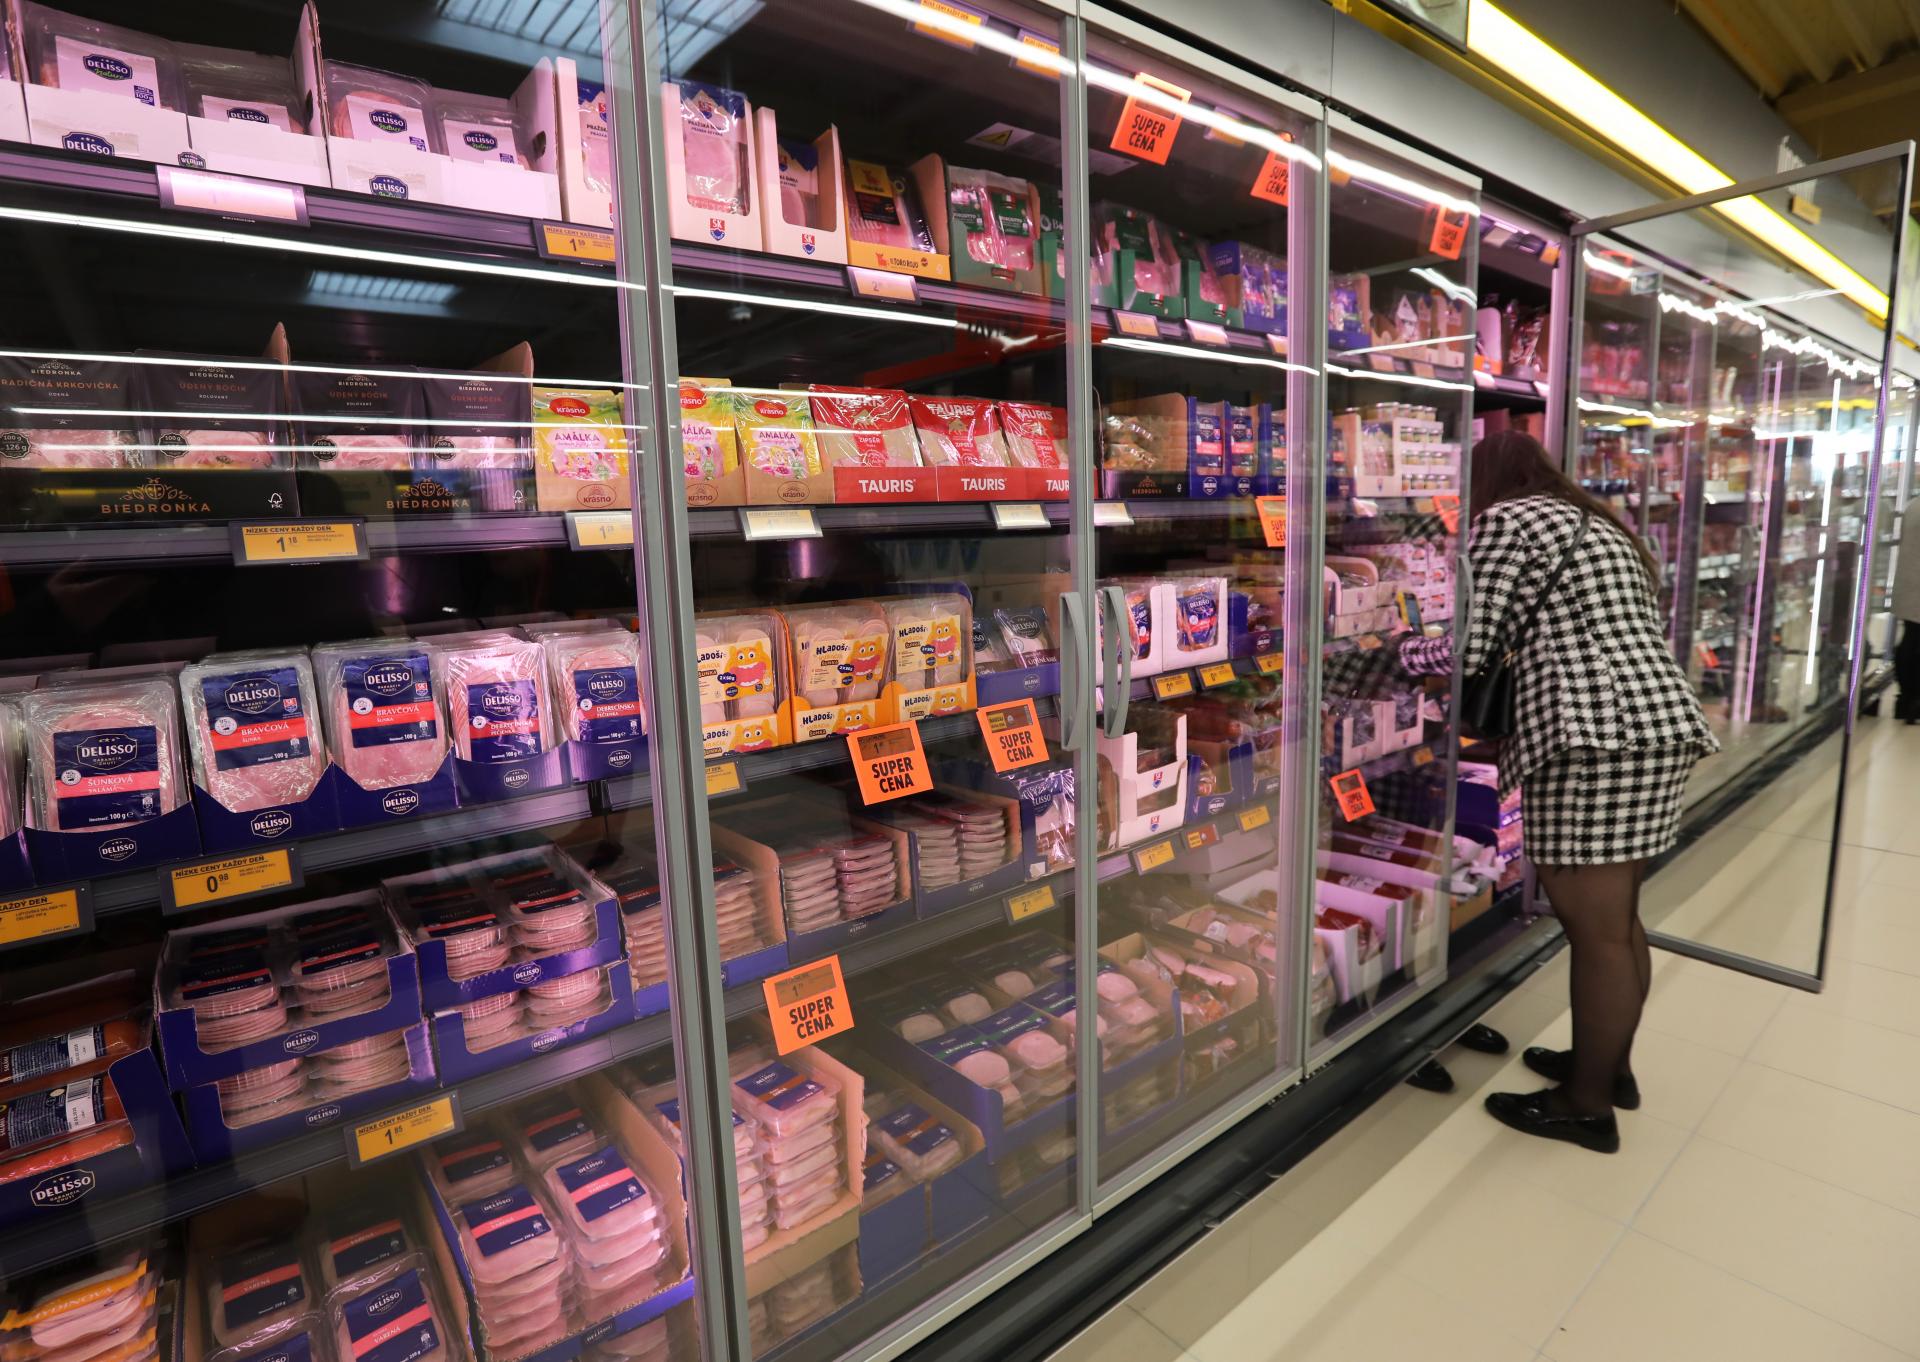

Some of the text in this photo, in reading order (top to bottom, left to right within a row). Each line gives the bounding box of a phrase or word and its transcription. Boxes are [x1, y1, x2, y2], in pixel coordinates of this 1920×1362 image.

[87, 59, 128, 74] DELISSO
[230, 111, 266, 122] DELISSO
[372, 114, 404, 128] DELISSO
[1131, 114, 1166, 138] SUPER
[66, 140, 110, 156] DELISSO
[466, 136, 495, 146] DELISSO
[1129, 132, 1156, 152] CENA
[372, 182, 405, 195] DELISSO
[1265, 180, 1287, 196] CENA
[0, 379, 120, 390] RADIČNÁ KRKOVIČKA
[680, 396, 702, 405] rásno
[926, 403, 975, 418] TAURIS
[1014, 407, 1053, 421] TAURIS
[554, 431, 601, 443] AMÁLKA
[858, 479, 914, 493] TAURIS
[960, 478, 1006, 492] TAURIS
[1046, 479, 1069, 492] TAUR
[101, 503, 212, 514] BIEDRONKA
[386, 499, 470, 510] BIEDRONKA
[246, 524, 332, 535] NÍZKE CENY KAŽDÝ DEŇ
[276, 537, 286, 552] 1
[368, 672, 410, 685] DELISSO
[591, 680, 623, 690] DELISSO
[229, 687, 277, 704] DELISSO
[485, 694, 520, 706] DELISSO
[376, 705, 420, 717] BRAVČOVÁ
[596, 703, 635, 712] DEBRECÍNSKA
[241, 722, 289, 736] BRAVČOVÁ
[1000, 731, 1033, 749] SUPER
[81, 743, 136, 758] DELISSO
[1007, 746, 1034, 763] CENA
[610, 754, 630, 763] DELISSO
[872, 757, 914, 779] SUPER
[87, 775, 134, 787] ŠUNKOVÁ
[506, 774, 527, 783] DELISSO
[879, 774, 915, 793] CENA
[385, 796, 416, 807] DELISSO
[254, 818, 289, 831] DELISSO
[102, 843, 134, 855] DELISSO
[175, 855, 265, 878] NÍZKE CENY KAŽDÝ DEŇ
[206, 873, 229, 893] 0 98
[29, 896, 48, 906] DEŇ
[515, 967, 541, 981] DELISSO
[789, 995, 834, 1025] SUPER
[796, 1013, 834, 1039] CENA
[286, 1034, 318, 1051] DELISSO
[533, 1035, 559, 1049] DELISSO
[308, 1108, 339, 1124] DELISSO
[358, 1104, 432, 1135] NÍZKE CENY KAŽDÝ DEŇ
[385, 1129, 393, 1145] 1
[36, 1176, 91, 1200] DELISSO
[369, 1291, 400, 1313] DELISSO
[373, 1326, 401, 1344] VARENÁ
